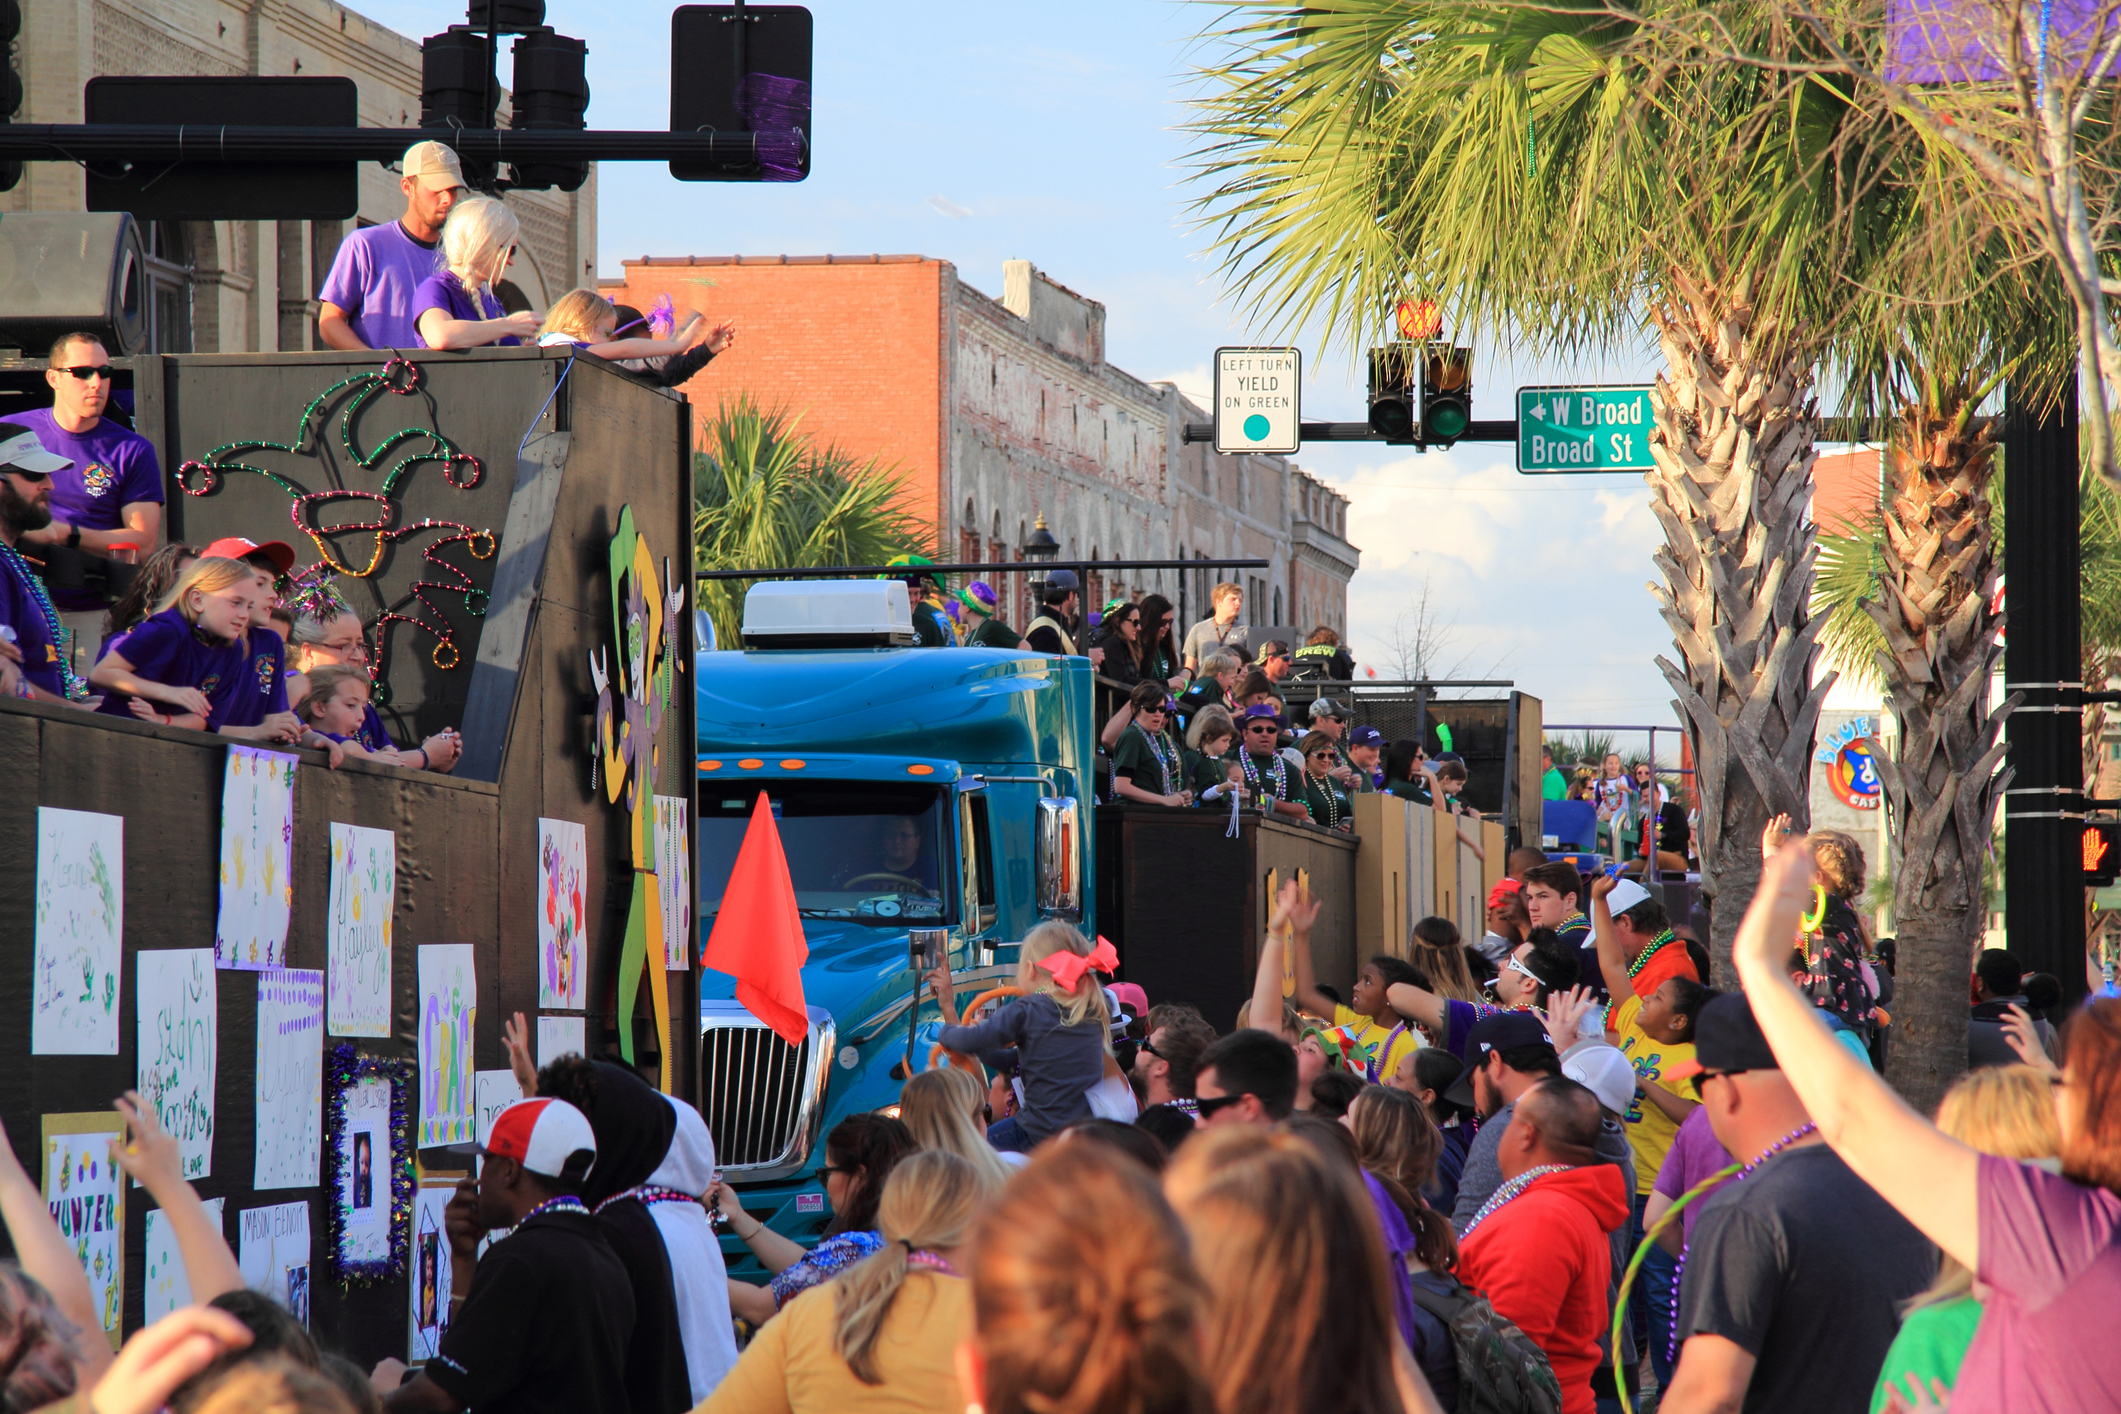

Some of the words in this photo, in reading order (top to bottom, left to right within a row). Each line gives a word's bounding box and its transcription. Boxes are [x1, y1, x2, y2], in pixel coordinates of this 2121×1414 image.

[1222, 359, 1252, 371] LEFT
[1260, 359, 1292, 371] TURN
[1237, 376, 1279, 391] YIELD
[1224, 396, 1241, 408] ON
[1248, 396, 1289, 408] GREEN
[1552, 396, 1571, 426] W
[1581, 395, 1642, 426] Broad
[1532, 433, 1594, 464] Broad
[1609, 432, 1633, 463] St
[1816, 715, 1872, 768] BLUE
[1849, 794, 1880, 809] CAF
[424, 993, 476, 1119] GRACE
[48, 1193, 114, 1239] HUNTER
[244, 1208, 271, 1243] MASON
[274, 1205, 304, 1239] BENOIT
